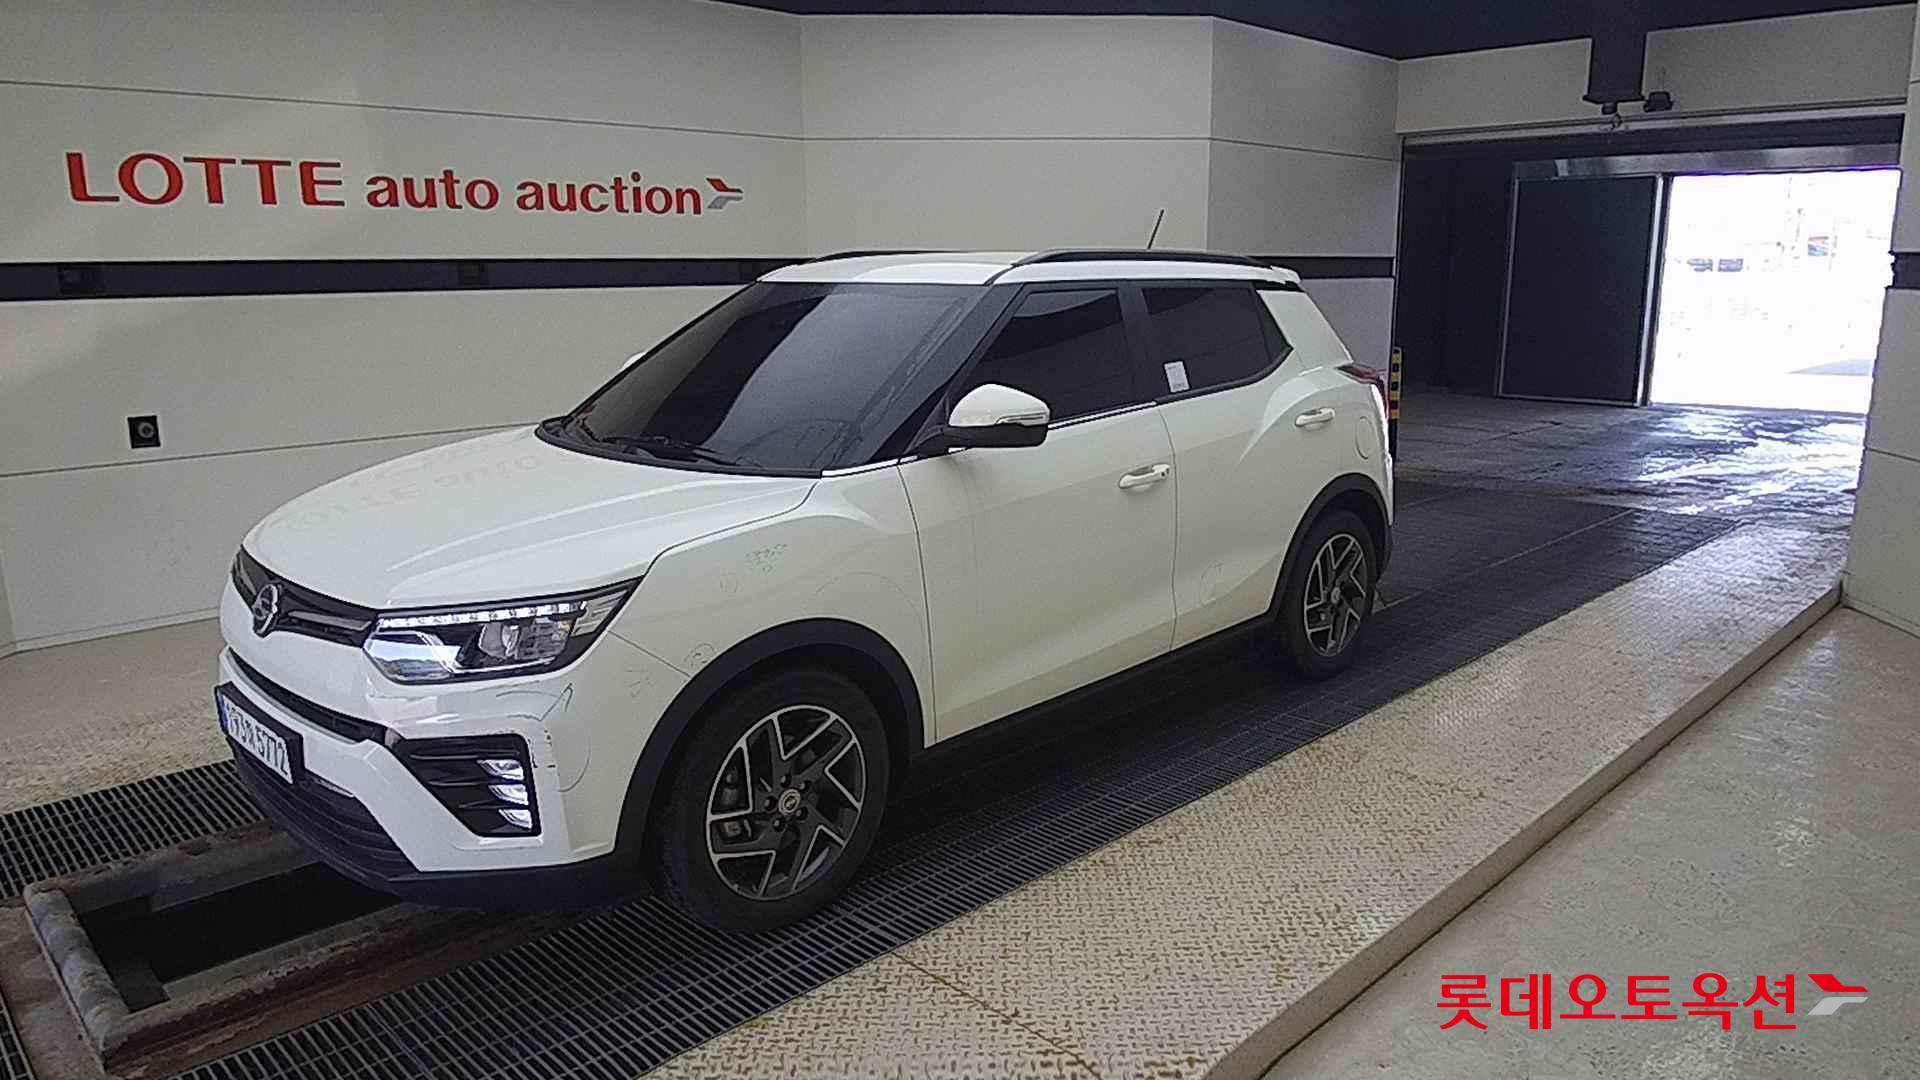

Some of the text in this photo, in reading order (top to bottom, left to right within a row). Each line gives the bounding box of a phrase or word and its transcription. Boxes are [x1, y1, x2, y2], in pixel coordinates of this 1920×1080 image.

[66, 152, 702, 215] LOTTE auto auction
[255, 724, 289, 777] 5772
